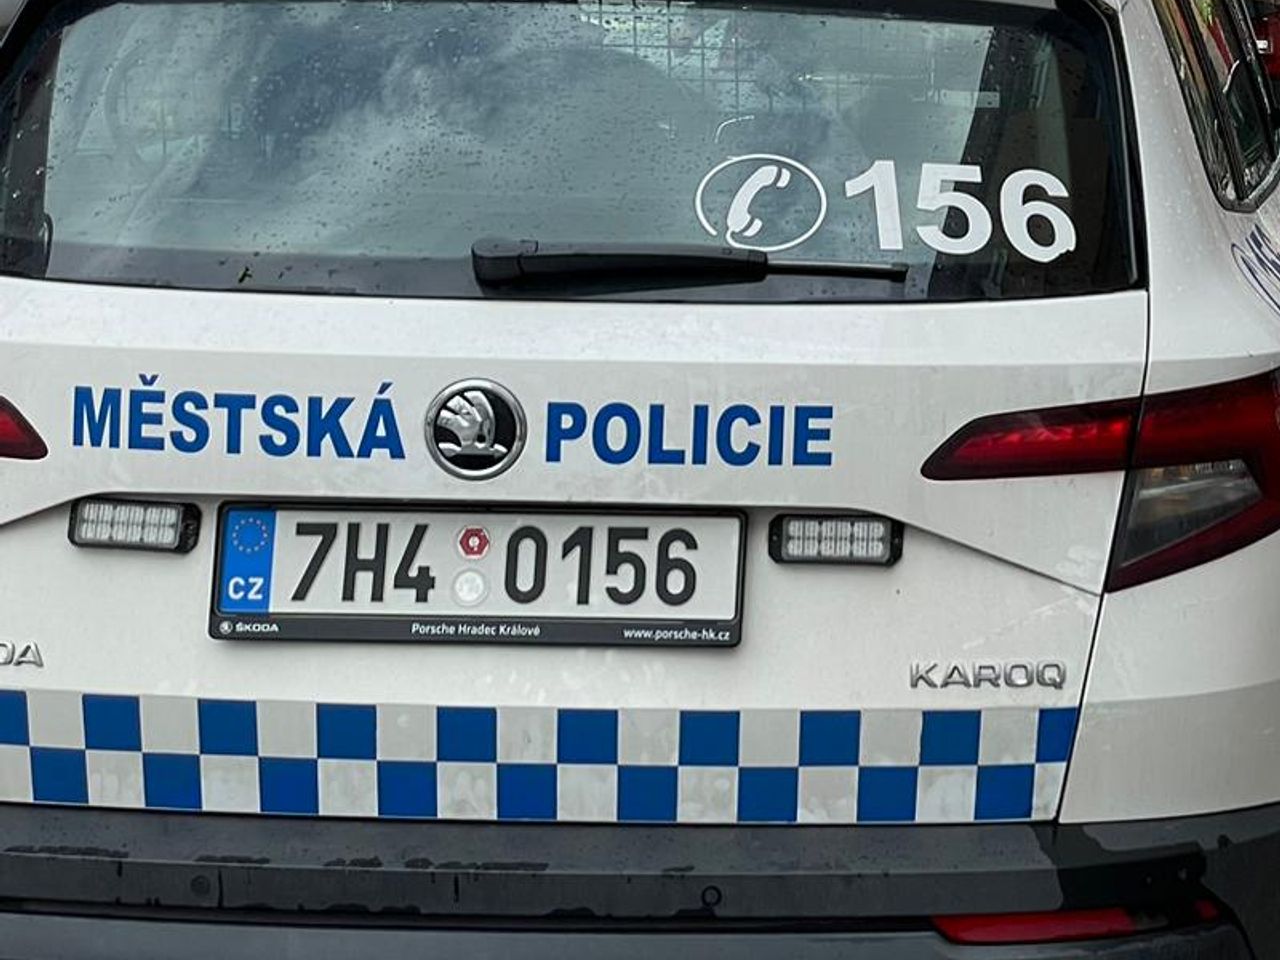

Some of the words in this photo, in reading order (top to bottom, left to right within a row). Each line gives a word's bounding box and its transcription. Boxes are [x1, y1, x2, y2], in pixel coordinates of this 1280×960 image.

[845, 160, 1077, 262] 156
[72, 374, 405, 459] MĚSTSKÁ
[546, 401, 834, 467] POLICIE
[228, 577, 264, 600] CZ
[291, 521, 435, 603] 7H4
[505, 525, 698, 607] 0156
[235, 621, 279, 633] ŠKODA
[411, 623, 455, 635] Porsche
[458, 623, 497, 636] Hradec
[499, 624, 540, 637] Králové
[623, 628, 731, 641] www.porsche-hk.cz
[910, 661, 1068, 690] KAROQ
